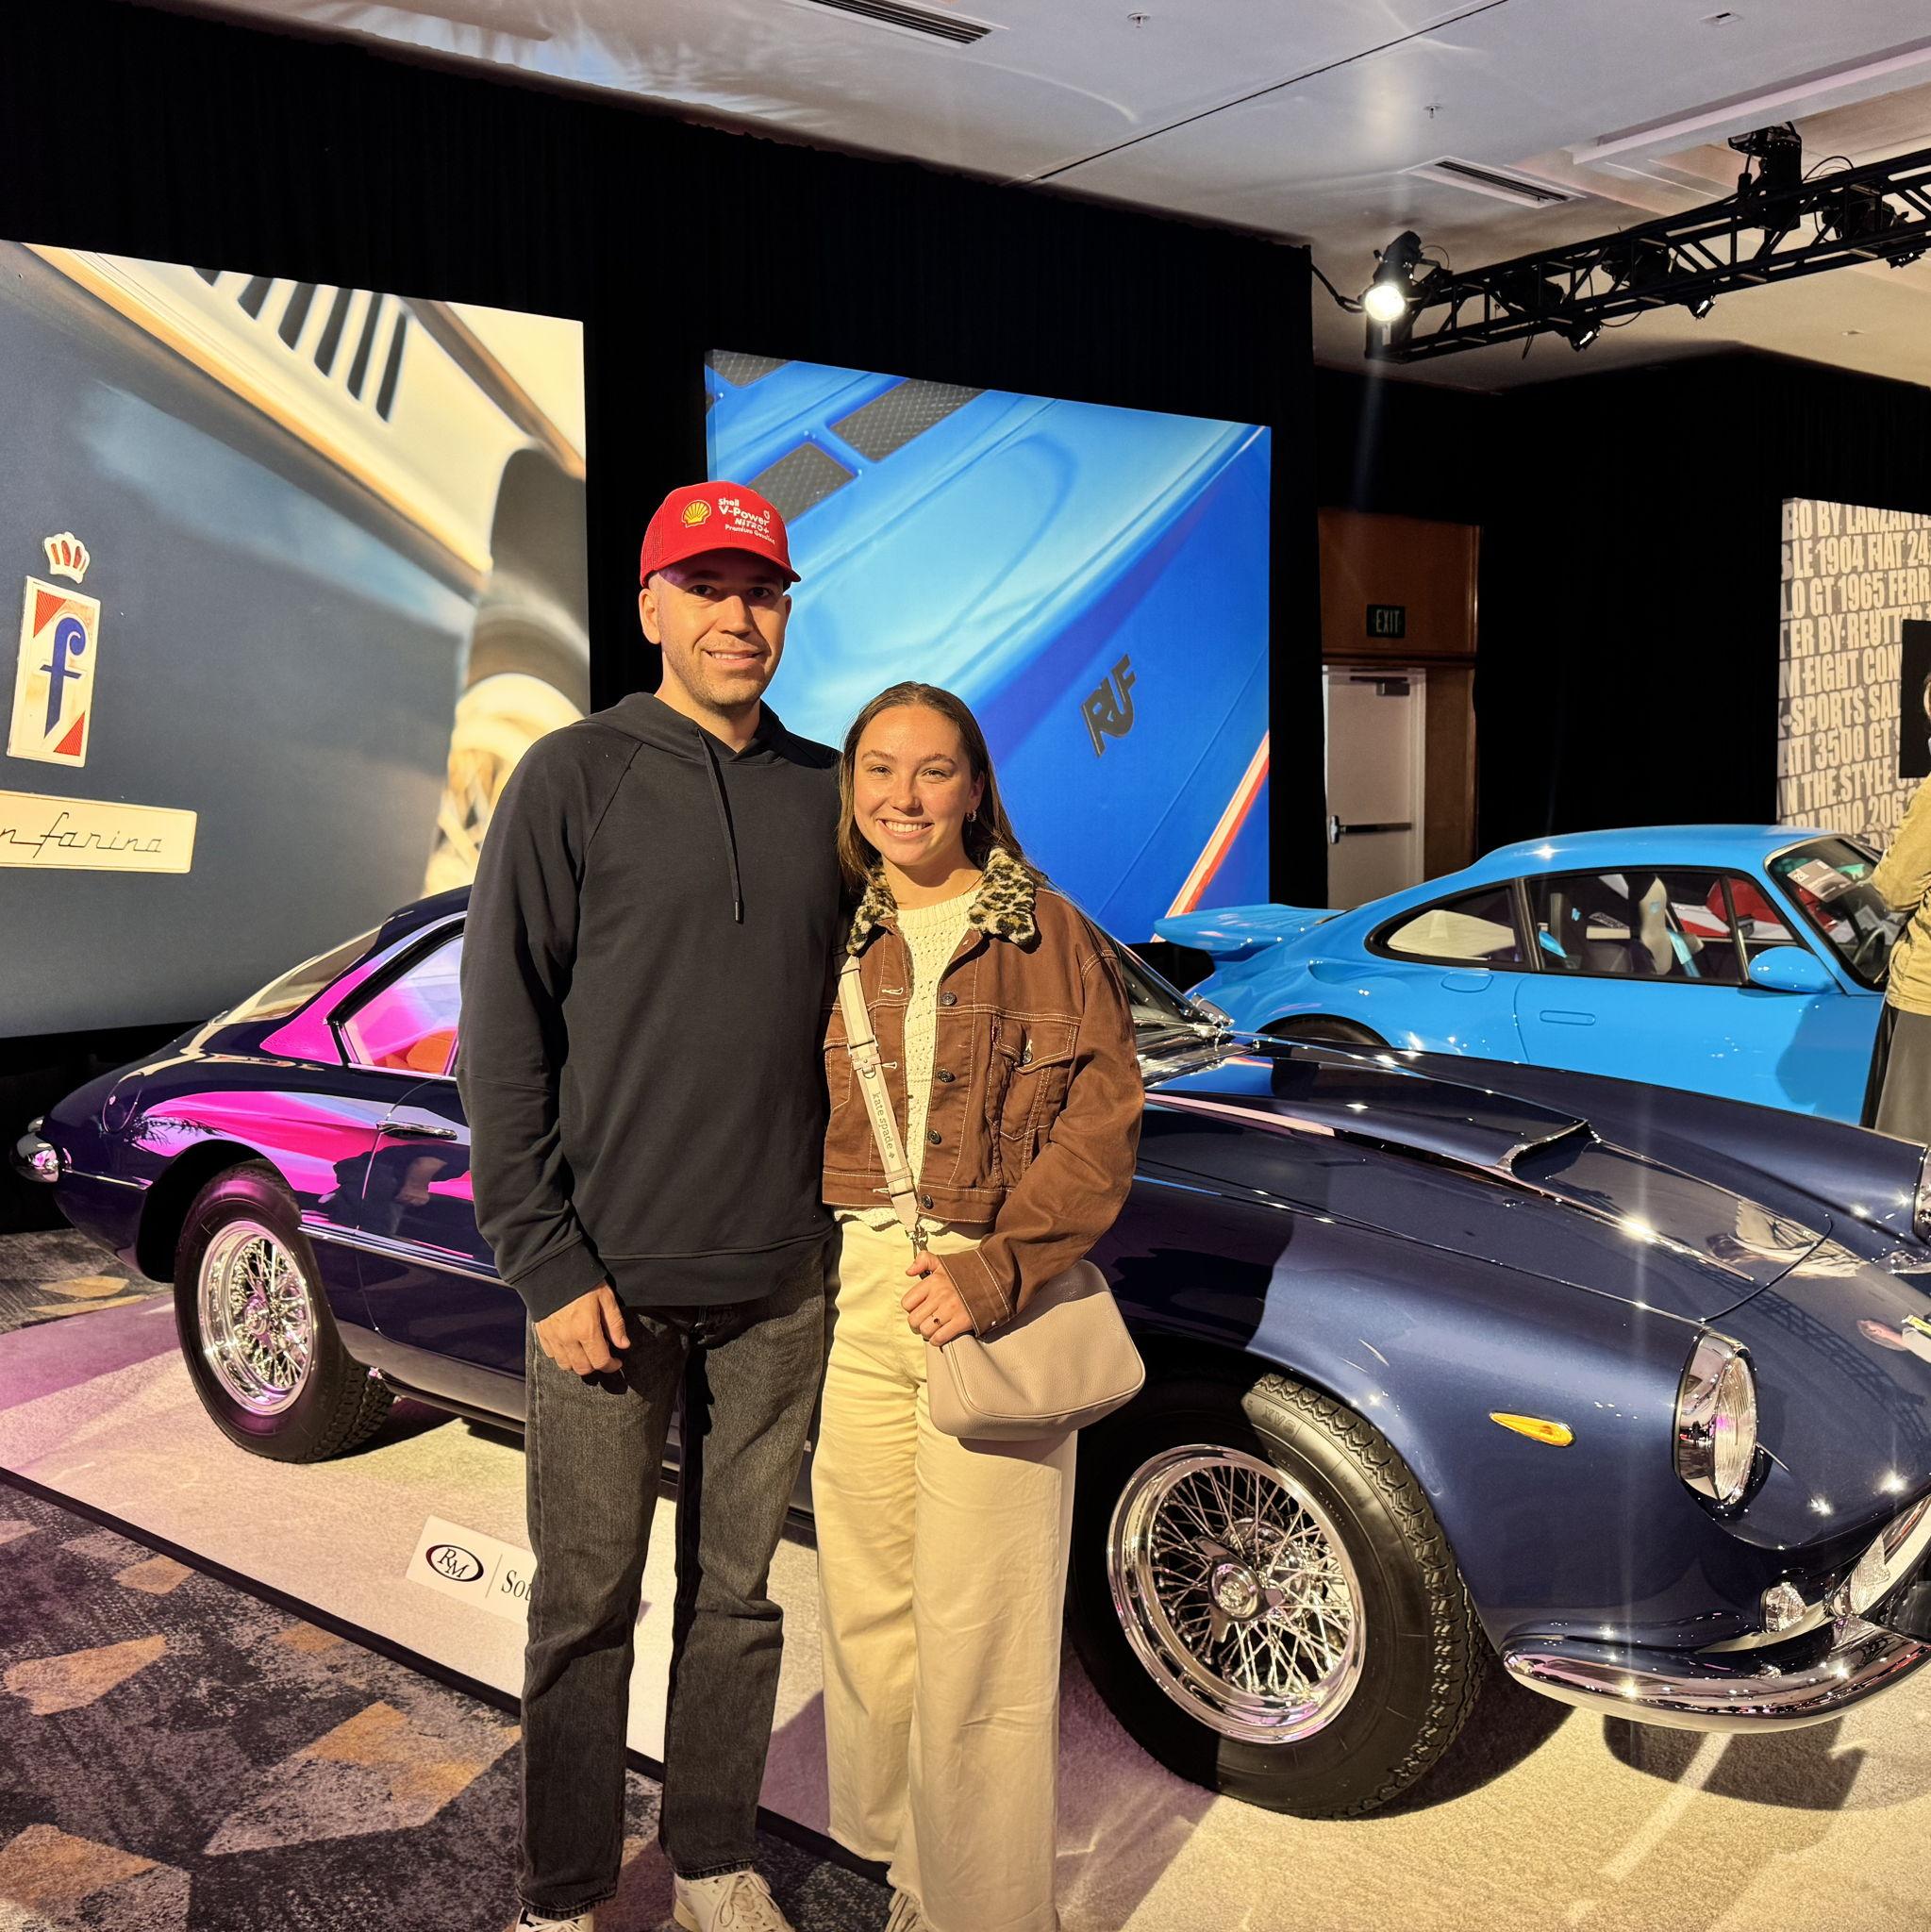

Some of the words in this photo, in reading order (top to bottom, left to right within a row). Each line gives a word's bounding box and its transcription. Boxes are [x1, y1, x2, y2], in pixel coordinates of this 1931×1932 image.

[718, 505, 770, 525] V-Power
[724, 524, 753, 534] Premium
[1817, 501, 1841, 537] BY
[1816, 535, 1864, 576] 1904
[1867, 531, 1904, 571] FIAT
[1809, 576, 1835, 616] GT
[1838, 572, 1885, 612] 1965
[1888, 566, 1931, 607] FERR
[1375, 608, 1400, 634] EXIT
[1818, 613, 1843, 655] BY
[1803, 651, 1859, 696] EIGHT
[1862, 643, 1903, 685] CON
[1080, 653, 1136, 758] RUF
[1790, 687, 1866, 736] SPORTS
[1814, 724, 1865, 771] 3500
[1869, 719, 1892, 758] GT
[1800, 767, 1838, 811] THE
[1839, 757, 1893, 802] STYLE
[1868, 791, 1905, 828] 206
[872, 1091, 885, 1119] kate
[879, 1118, 894, 1150] spade
[437, 1548, 470, 1578] RM
